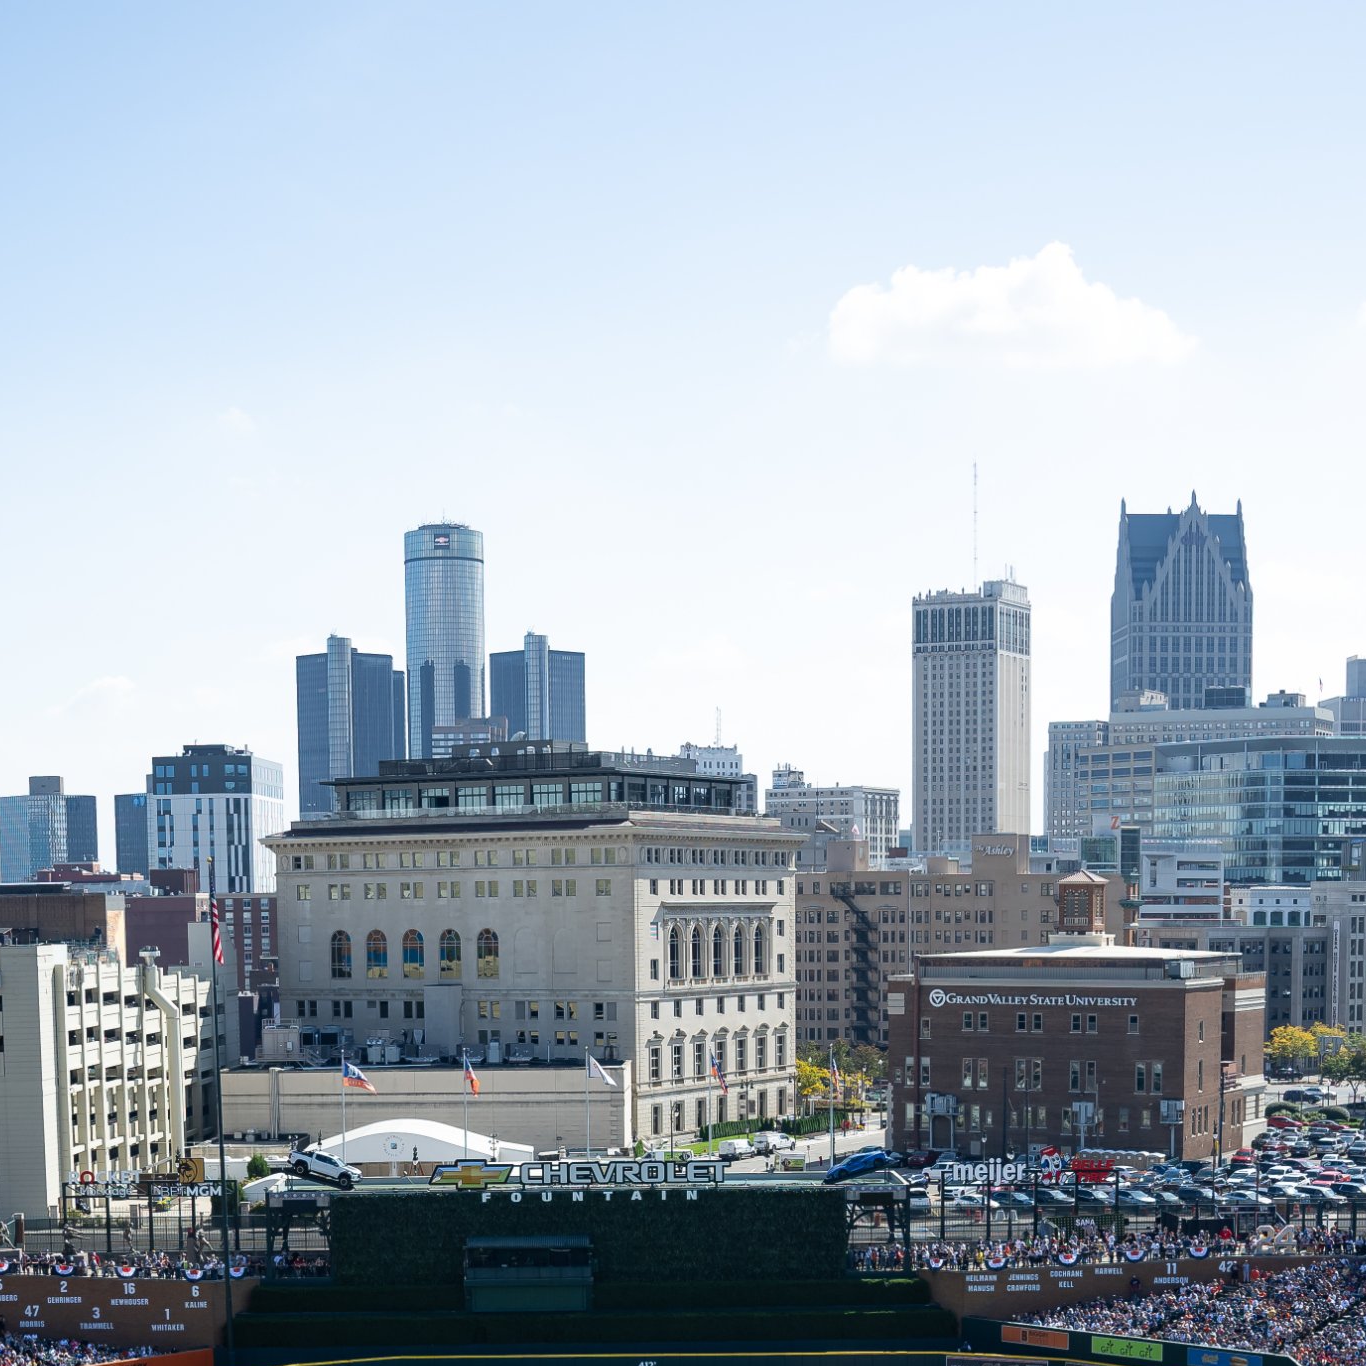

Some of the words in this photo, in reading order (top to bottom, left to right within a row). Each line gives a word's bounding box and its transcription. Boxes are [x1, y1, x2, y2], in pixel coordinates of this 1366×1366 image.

[945, 992, 988, 1005] GRAND
[987, 993, 1028, 1006] VALLEY
[1029, 994, 1065, 1006] STATE
[1065, 995, 1138, 1007] UNIVERSITY
[1071, 1159, 1116, 1170] BELLE
[69, 1169, 142, 1185] ROCKET
[519, 1161, 731, 1185] CHEVROLET
[953, 1158, 1027, 1186] meijer
[1077, 1172, 1110, 1183] TIRE
[79, 1186, 132, 1199] Mortgage
[481, 1190, 699, 1203] FOUNTAIN
[1094, 1267, 1124, 1275] HARWELL
[1166, 1262, 1178, 1275] 11
[1218, 1261, 1233, 1273] 42
[966, 1274, 998, 1282] HEILMANN
[1007, 1274, 1039, 1282] JENNINGS
[1050, 1270, 1084, 1278] COCHRANE
[1058, 1280, 1074, 1289] KELL
[1153, 1276, 1189, 1285] ANDERSON
[60, 1280, 68, 1293] 2
[123, 1282, 136, 1295] 16
[191, 1284, 200, 1298] 6
[968, 1285, 995, 1293] MANUSH
[1007, 1284, 1041, 1292] CRAWFORD
[47, 1296, 82, 1304] GEHRINGER
[111, 1298, 149, 1306] NEWHOUSER
[185, 1300, 208, 1309] KALINE
[24, 1305, 40, 1317] 47
[91, 1307, 101, 1319] 3
[19, 1320, 45, 1329] MORRIS
[79, 1322, 114, 1330] TRAMMELL
[151, 1324, 185, 1332] WHITAKER
